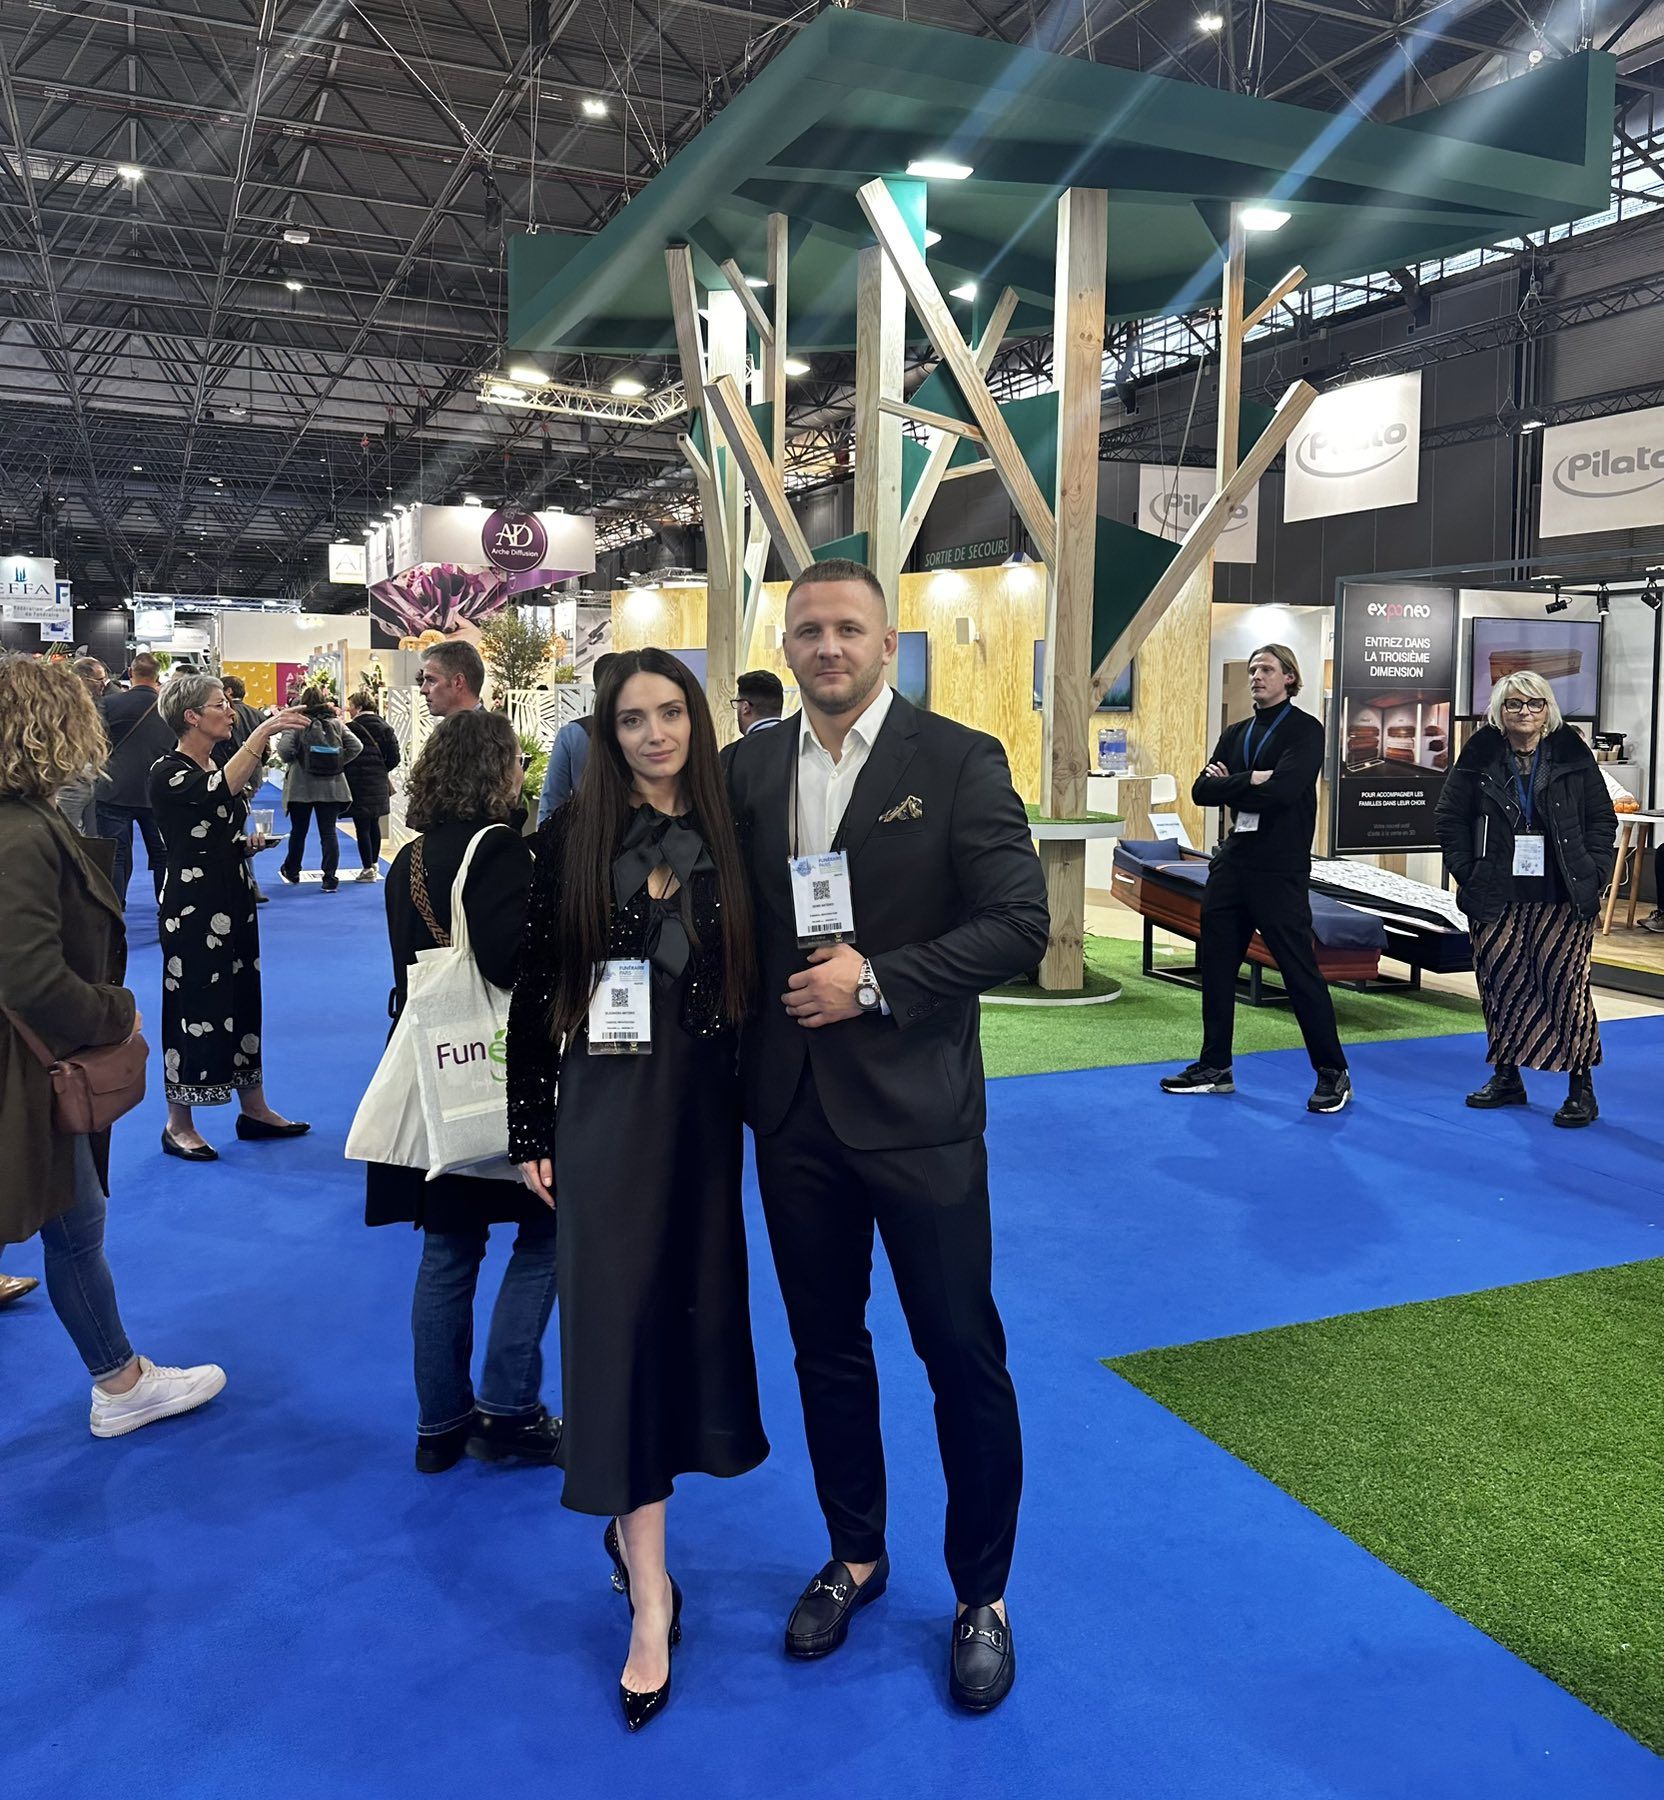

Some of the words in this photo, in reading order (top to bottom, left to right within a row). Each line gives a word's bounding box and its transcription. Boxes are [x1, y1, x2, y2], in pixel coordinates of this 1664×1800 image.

[1162, 492, 1249, 520] Pilo
[491, 548, 510, 556] Arche
[510, 548, 539, 558] Diffusion
[924, 549, 953, 568] SORTIE
[954, 546, 966, 562] DE
[967, 538, 1009, 560] SECOURS
[1366, 602, 1432, 624] exponeo
[1365, 636, 1403, 648] ENTREZ
[1404, 637, 1431, 649] DANS
[1364, 651, 1378, 662] LA
[1379, 650, 1431, 663] TROISIÈME
[1369, 665, 1424, 678] DIMENSION
